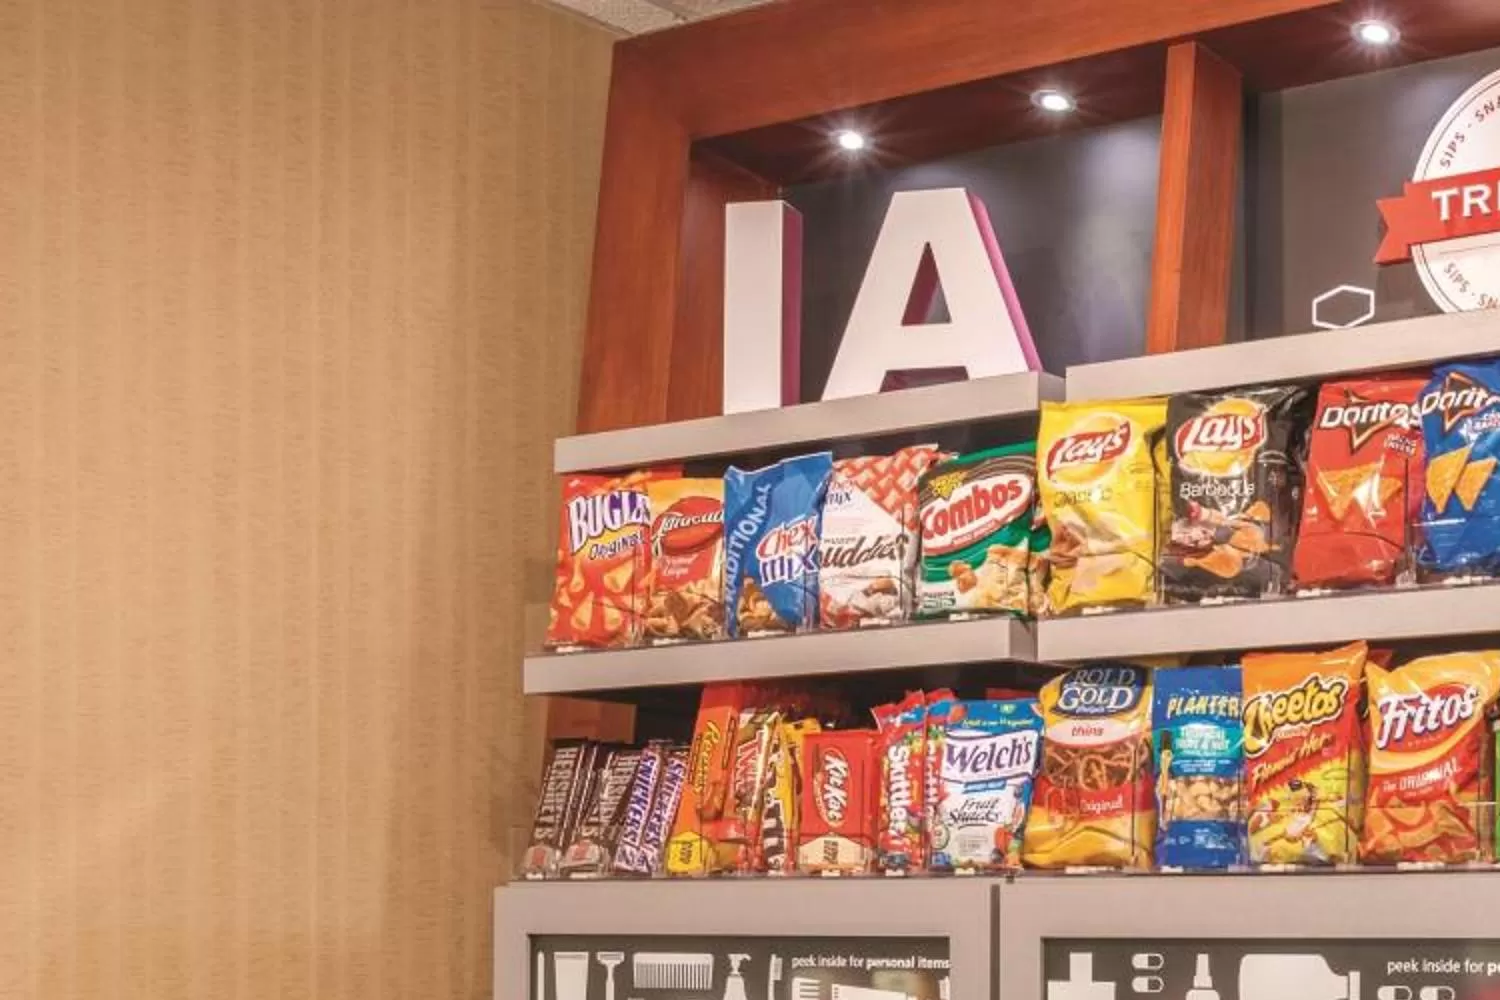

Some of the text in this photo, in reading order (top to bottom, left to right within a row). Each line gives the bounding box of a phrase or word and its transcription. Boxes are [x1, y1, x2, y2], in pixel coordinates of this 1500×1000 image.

[1440, 131, 1466, 168] SIPS
[1443, 262, 1470, 294] SIPS
[1320, 401, 1422, 430] Doritos
[922, 479, 1023, 541] Combos
[757, 514, 818, 560] Chex
[1058, 685, 1134, 711] GOLD
[1166, 695, 1242, 719] PLANTER
[1245, 677, 1346, 754] Cheetos
[1377, 686, 1478, 749] Fritos
[947, 738, 1033, 773] Welch's
[849, 955, 864, 968] for
[866, 955, 915, 971] personal
[1387, 958, 1419, 976] peek
[1422, 958, 1461, 973] inside
[1465, 958, 1484, 973] for
